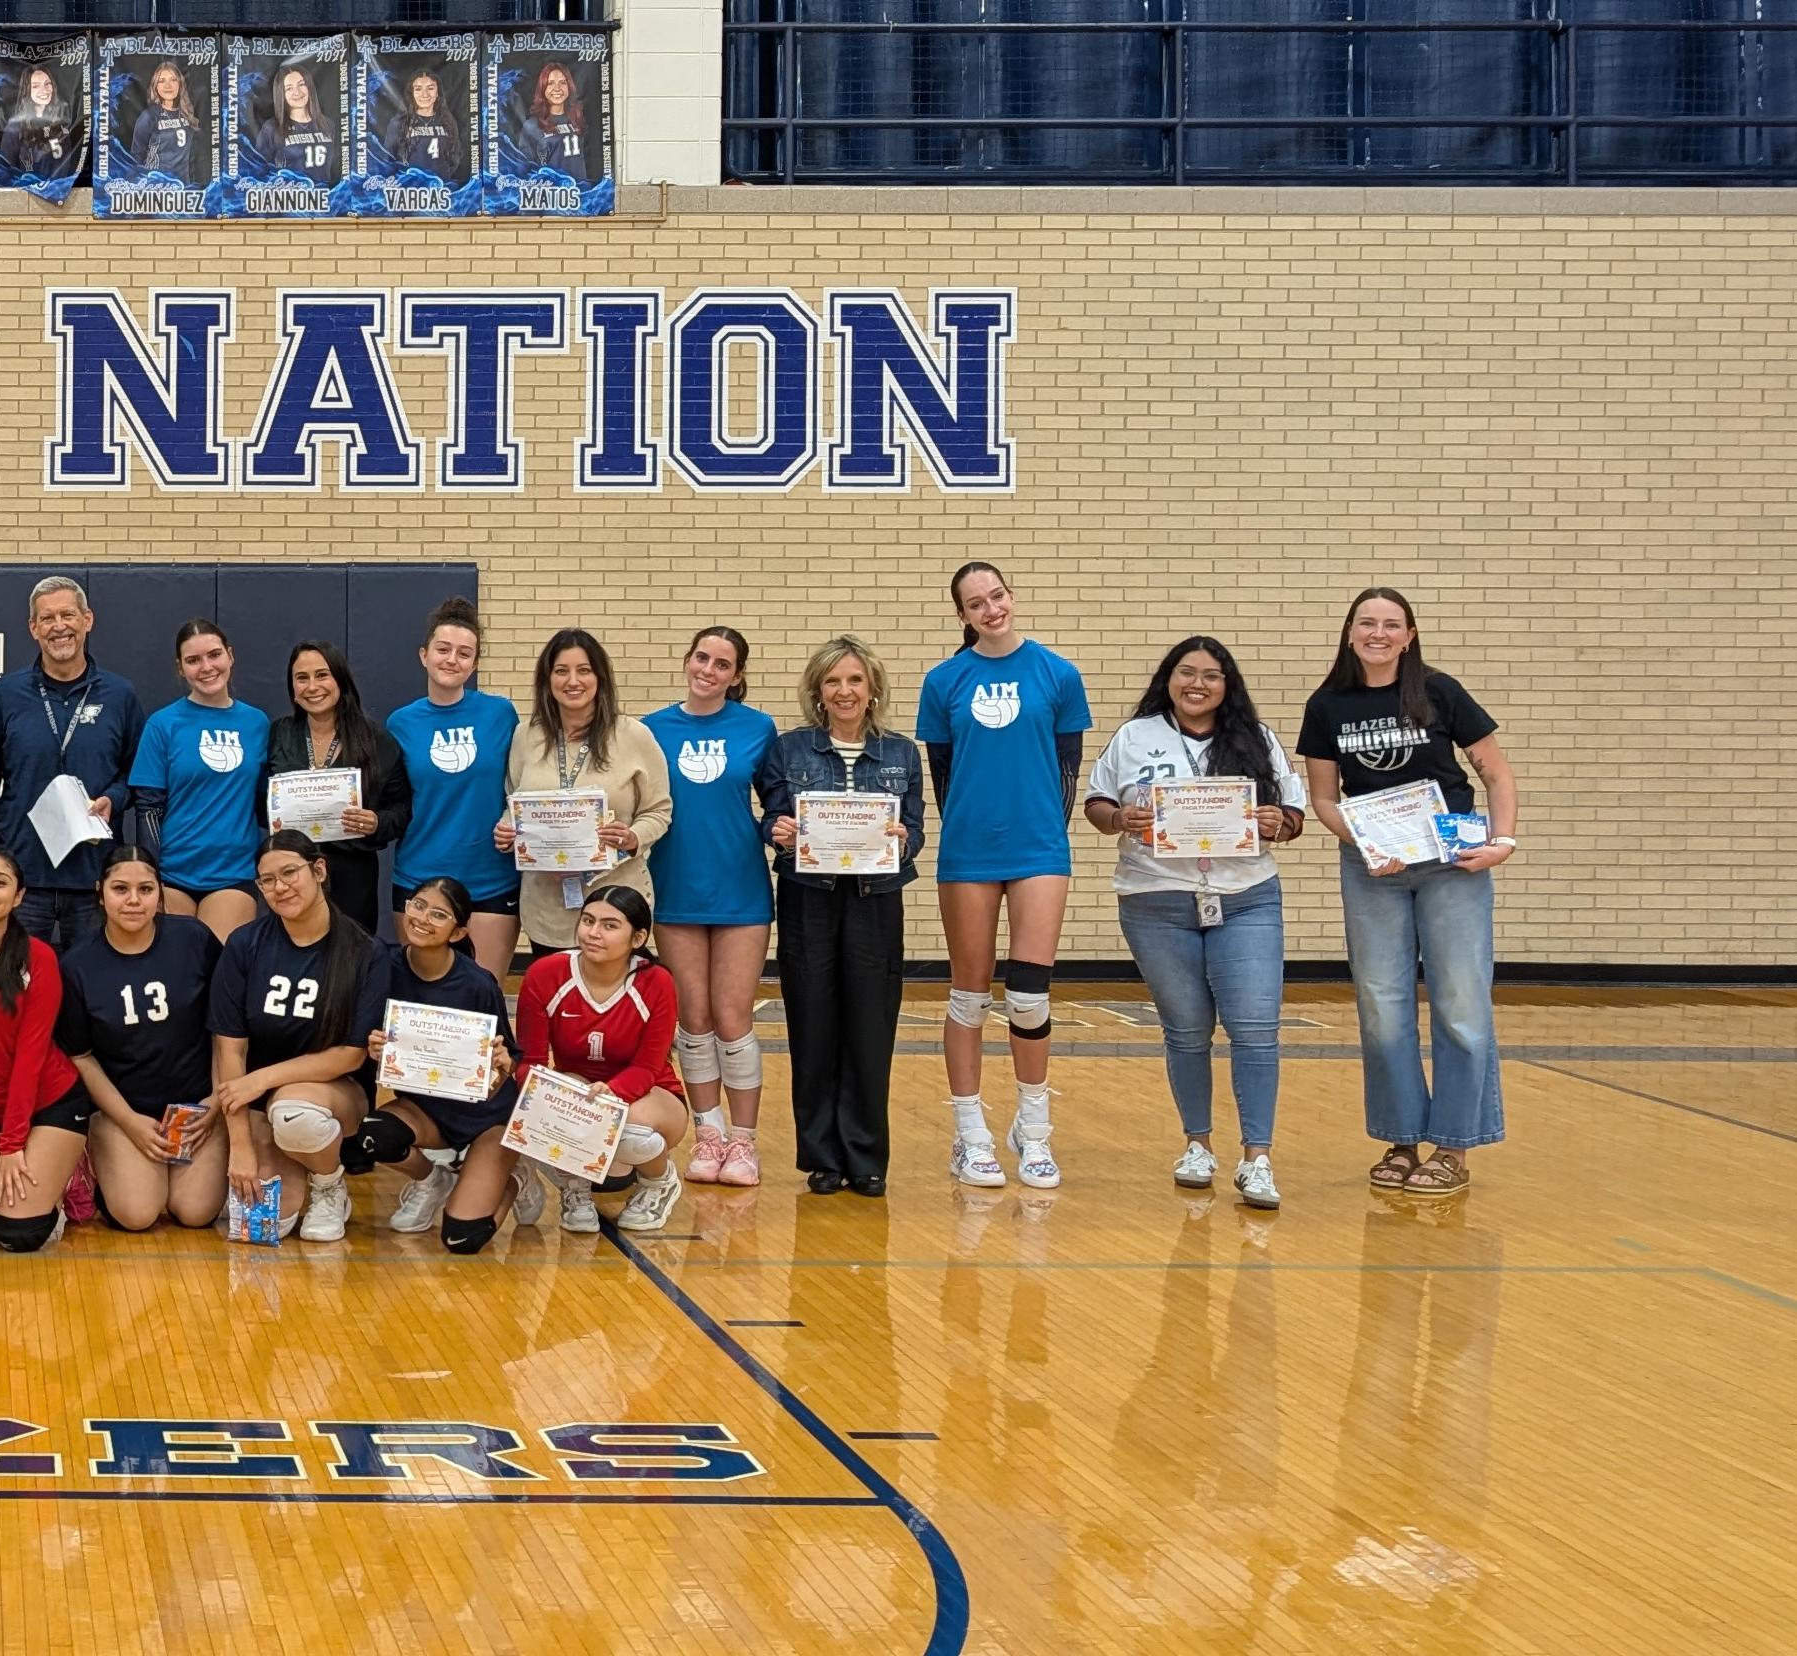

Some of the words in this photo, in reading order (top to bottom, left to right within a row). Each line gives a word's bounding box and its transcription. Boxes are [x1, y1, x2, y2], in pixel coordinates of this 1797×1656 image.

[124, 37, 216, 55] BLAZERS
[253, 35, 345, 55] BLAZERS
[380, 34, 474, 52] BLAZERS
[513, 33, 607, 51] BLAZERS
[82, 62, 91, 92] SCHOOL
[210, 64, 219, 93] SCHOOL
[340, 61, 348, 91] SCHOOL
[469, 60, 478, 90] SCHOOL
[601, 61, 610, 91] SCHOOL
[83, 95, 91, 115] HIGH
[98, 67, 109, 142] VOLLEYBALL
[211, 96, 219, 116] HIGH
[228, 65, 238, 140] VOLLEYBALL
[340, 93, 349, 113] HIGH
[356, 63, 367, 139] VOLLEYBALL
[470, 92, 478, 113] HIGH
[487, 63, 498, 139] VOLLEYBALL
[602, 93, 610, 113] HIGH
[83, 117, 91, 144] TRAIL
[175, 129, 187, 148] 9
[211, 118, 219, 145] TRAIL
[341, 116, 349, 143] TRAIL
[470, 115, 478, 142] TRAIL
[602, 116, 611, 142] TRAIL
[49, 139, 63, 160] 5
[304, 146, 328, 168] 16
[427, 138, 439, 159] 4
[488, 141, 499, 174] GIRLS
[562, 134, 580, 157] 11
[98, 145, 109, 178] GIRLS
[228, 143, 238, 176] GIRLS
[357, 142, 367, 175] GIRLS
[111, 190, 205, 214] DOMINGUEZ
[247, 189, 330, 213] GIANNONE
[385, 187, 451, 211] VARGAS
[520, 187, 581, 211] MATOS
[43, 286, 1017, 493] NATION
[972, 682, 1019, 701] AIM
[432, 726, 476, 748] AIM
[1341, 716, 1397, 734] BLAZER
[199, 729, 240, 747] AIM
[679, 739, 726, 757] AIM
[1337, 728, 1431, 754] VOLLEYBALL
[288, 784, 339, 794] OUTSTANDING
[1173, 796, 1233, 805] OUTSTANDING
[531, 810, 587, 819] OUTSTANDING
[817, 812, 877, 820] OUTSTANDING
[120, 981, 170, 1026] 13
[263, 975, 319, 1020] 22
[409, 1019, 471, 1036] OUTSTANDING
[587, 1031, 606, 1062] 1
[544, 1092, 604, 1123] OUTSTANDING
